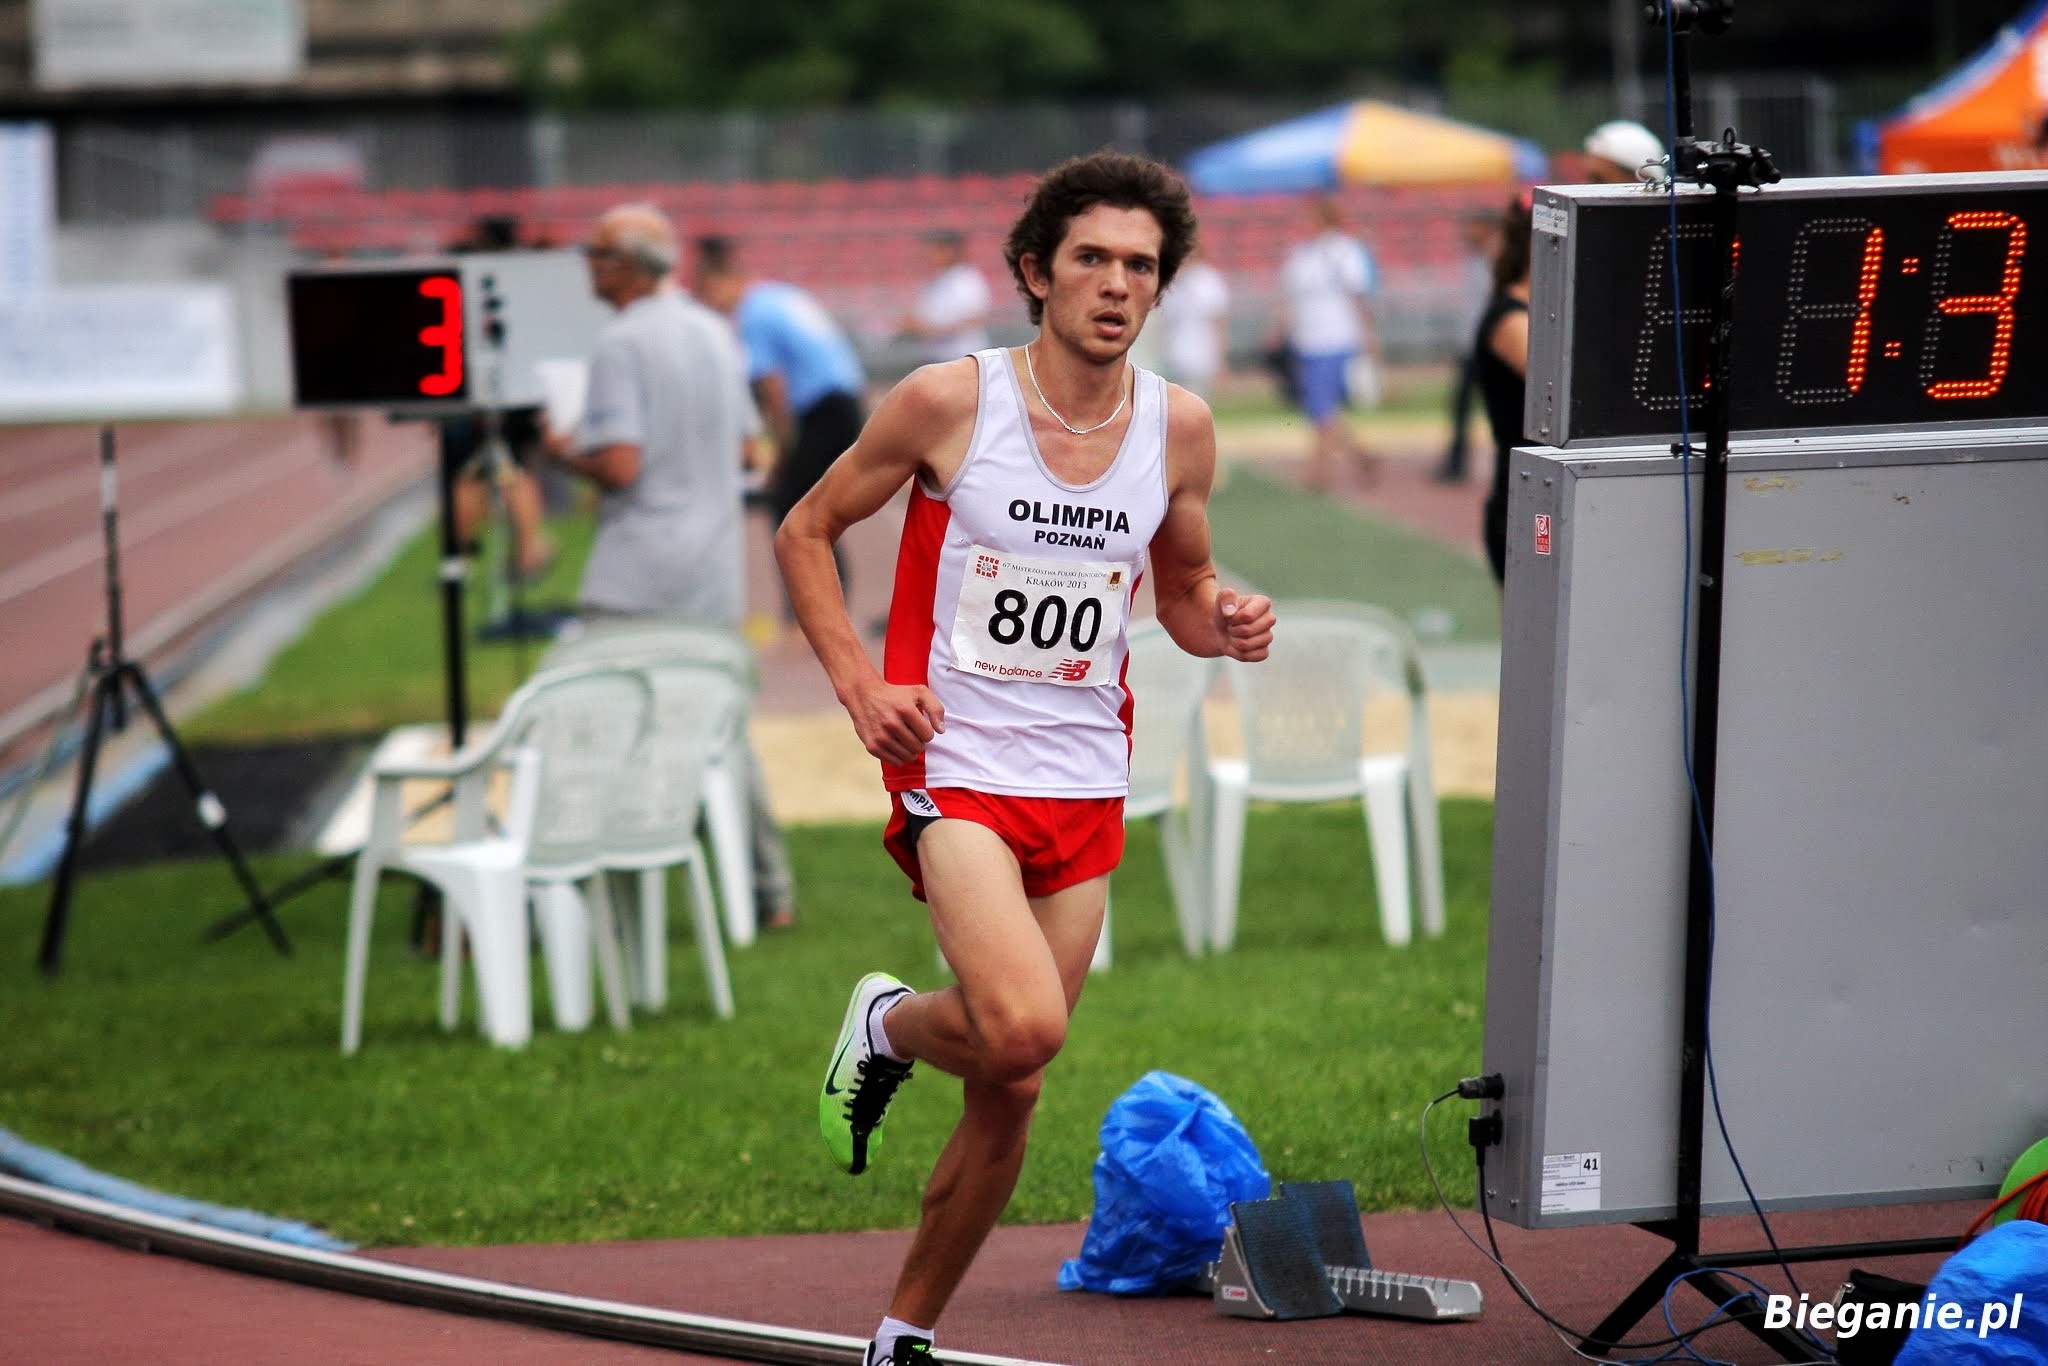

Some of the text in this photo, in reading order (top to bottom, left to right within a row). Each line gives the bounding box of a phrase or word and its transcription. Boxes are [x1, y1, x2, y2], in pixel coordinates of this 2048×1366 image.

[417, 275, 464, 397] 3
[1008, 499, 1130, 534] OLIMPIA
[1034, 530, 1106, 550] POZNAŃ
[1026, 575, 1087, 590] KRAKÓW 2013
[988, 589, 1102, 652] 800
[974, 660, 1043, 678] new balance
[1583, 1158, 1598, 1171] 41
